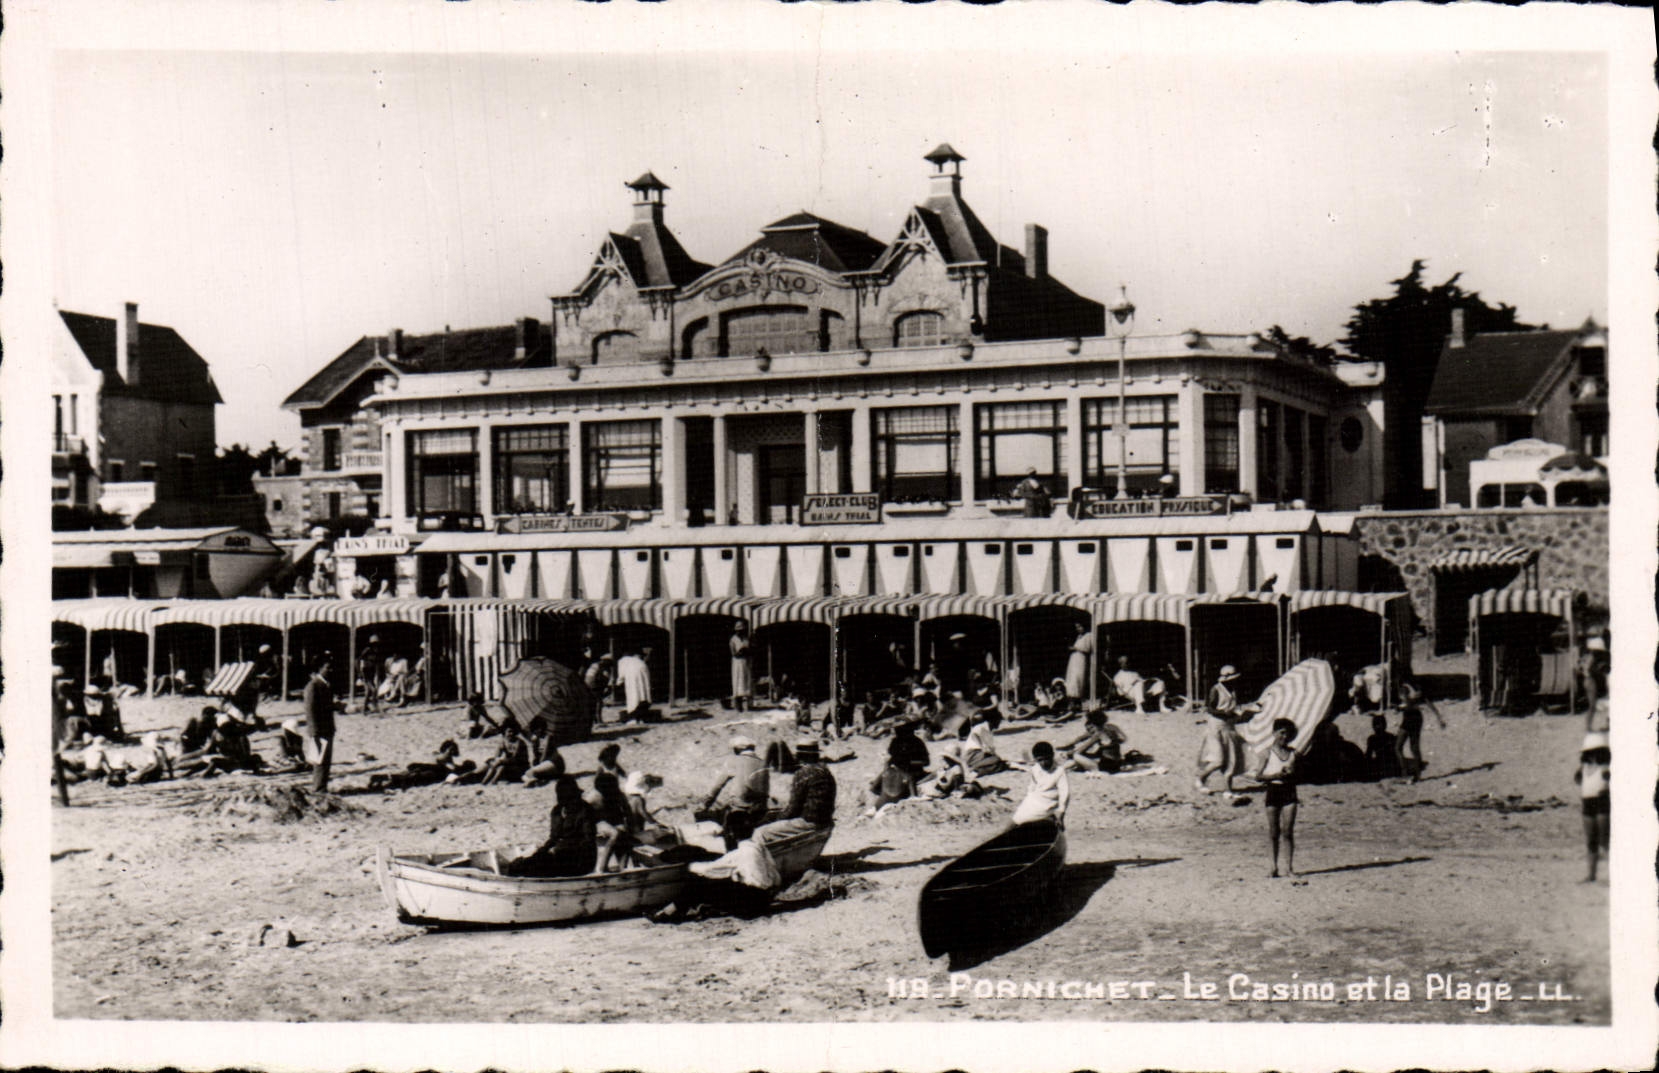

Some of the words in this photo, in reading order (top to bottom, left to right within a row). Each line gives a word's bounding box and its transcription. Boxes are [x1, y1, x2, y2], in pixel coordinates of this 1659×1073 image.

[718, 272, 806, 296] CASINO
[1092, 502, 1154, 515] EDUCATION
[1161, 500, 1214, 513] PHYSIQUE
[522, 518, 562, 530] CABINES
[570, 517, 604, 529] TENTES
